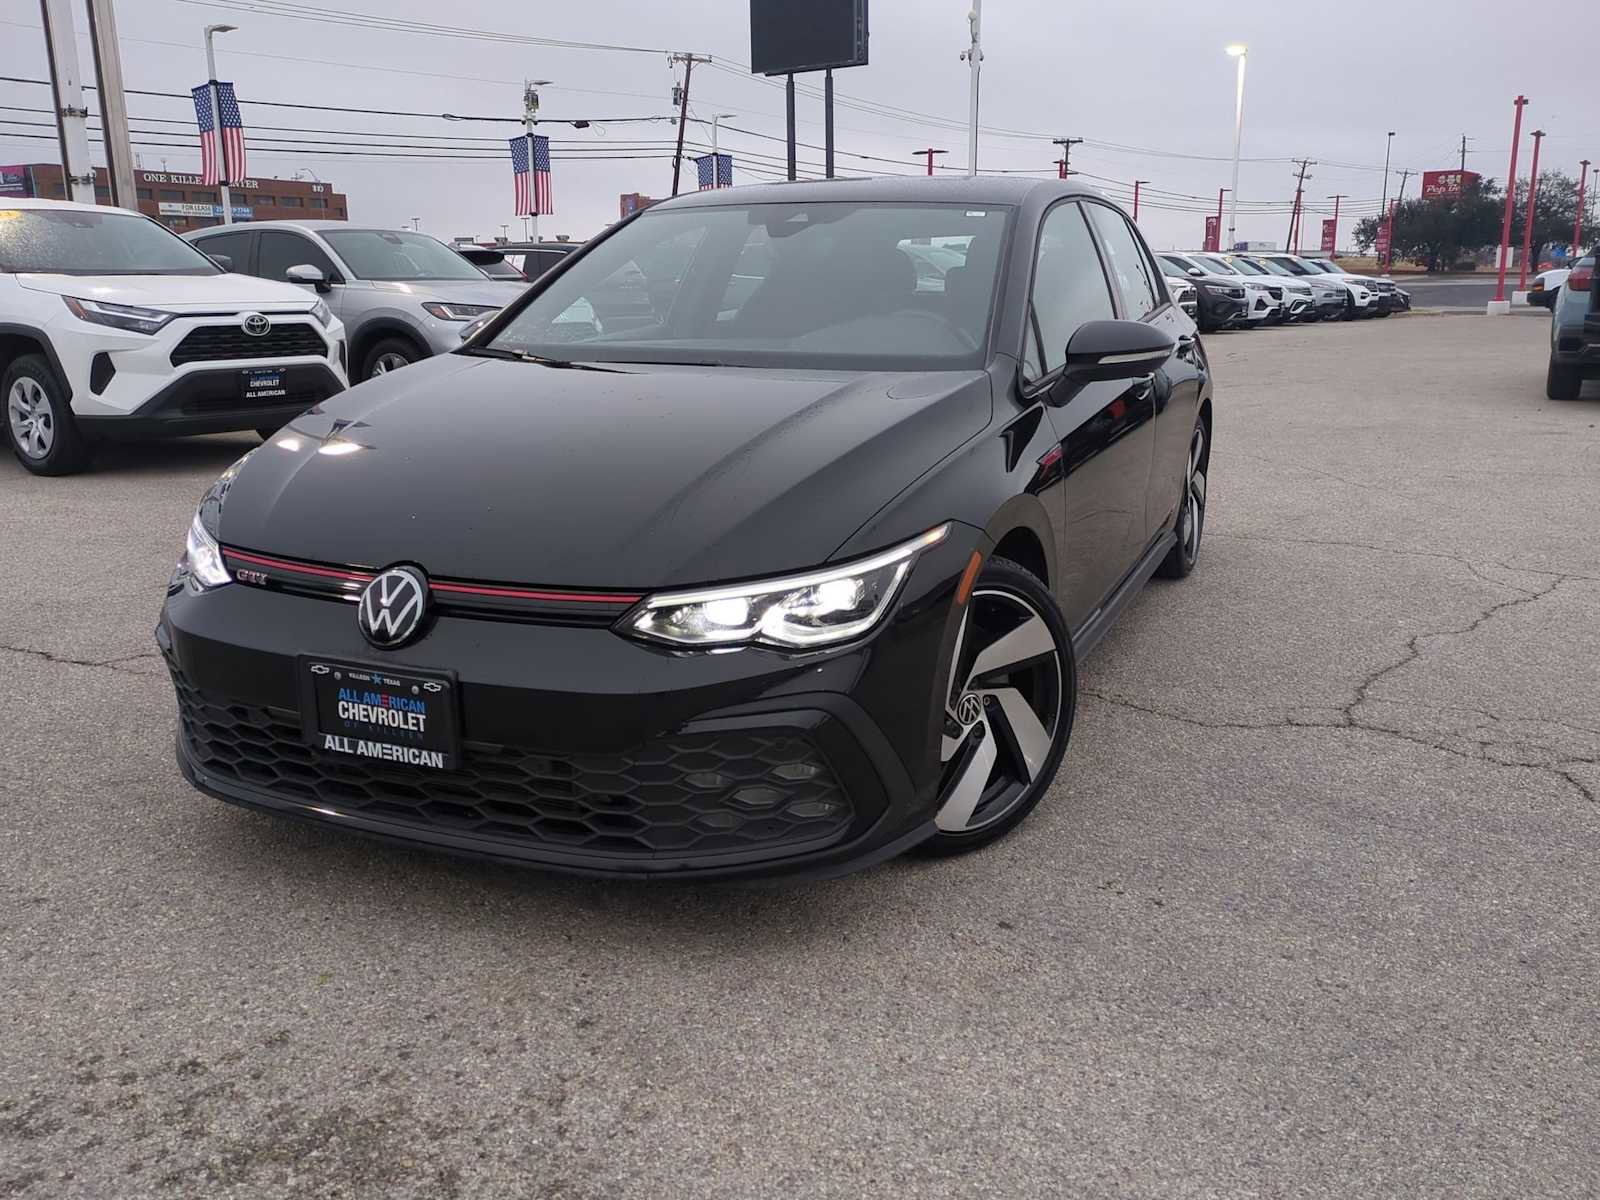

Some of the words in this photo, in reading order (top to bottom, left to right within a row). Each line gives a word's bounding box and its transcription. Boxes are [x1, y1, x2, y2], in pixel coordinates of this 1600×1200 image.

[143, 173, 167, 183] ONE
[236, 568, 270, 586] GTI
[383, 677, 401, 687] TEXAS
[338, 687, 361, 703] ALL
[362, 690, 426, 714] AMERICAN
[337, 701, 427, 733] CHEVROLET
[323, 734, 354, 754] ALL
[356, 740, 444, 769] AMERICAN
